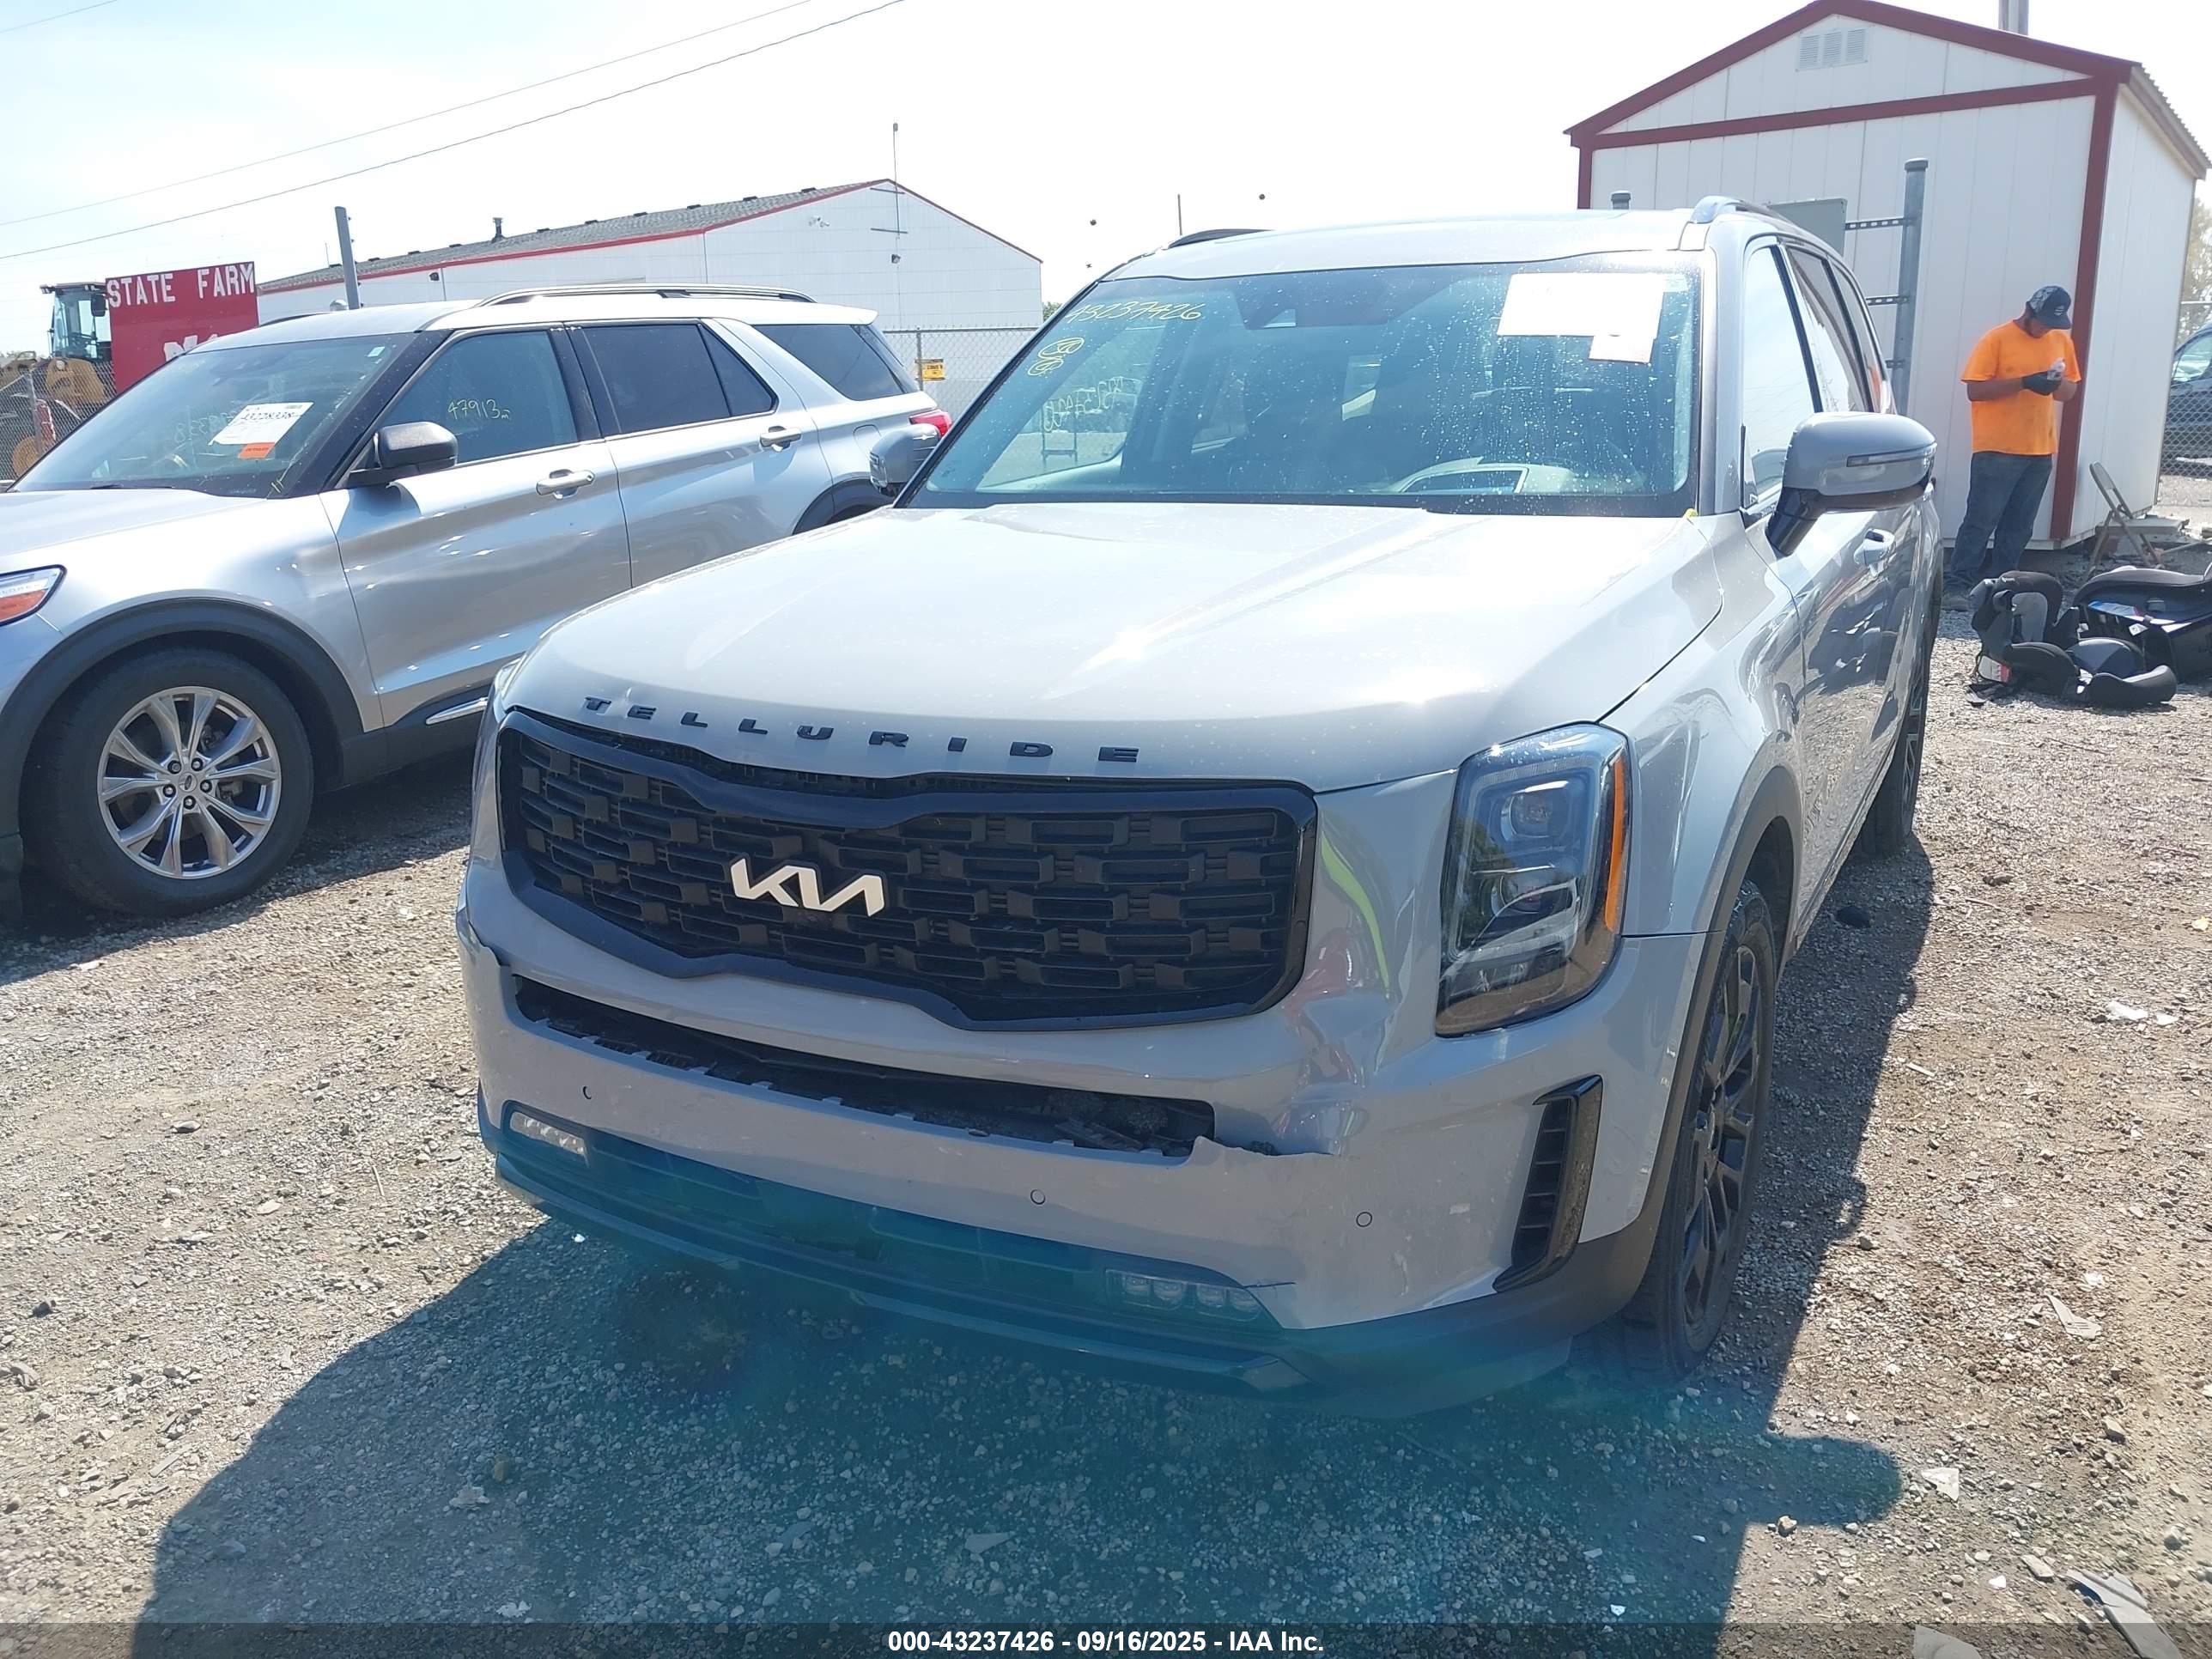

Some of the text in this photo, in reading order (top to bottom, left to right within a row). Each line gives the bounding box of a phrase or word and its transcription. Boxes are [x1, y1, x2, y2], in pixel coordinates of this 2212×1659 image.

[106, 264, 255, 307] STATE FARM
[447, 398, 501, 420] 47913
[584, 696, 1140, 763] TELLURIDE
[731, 858, 884, 917] KIA
